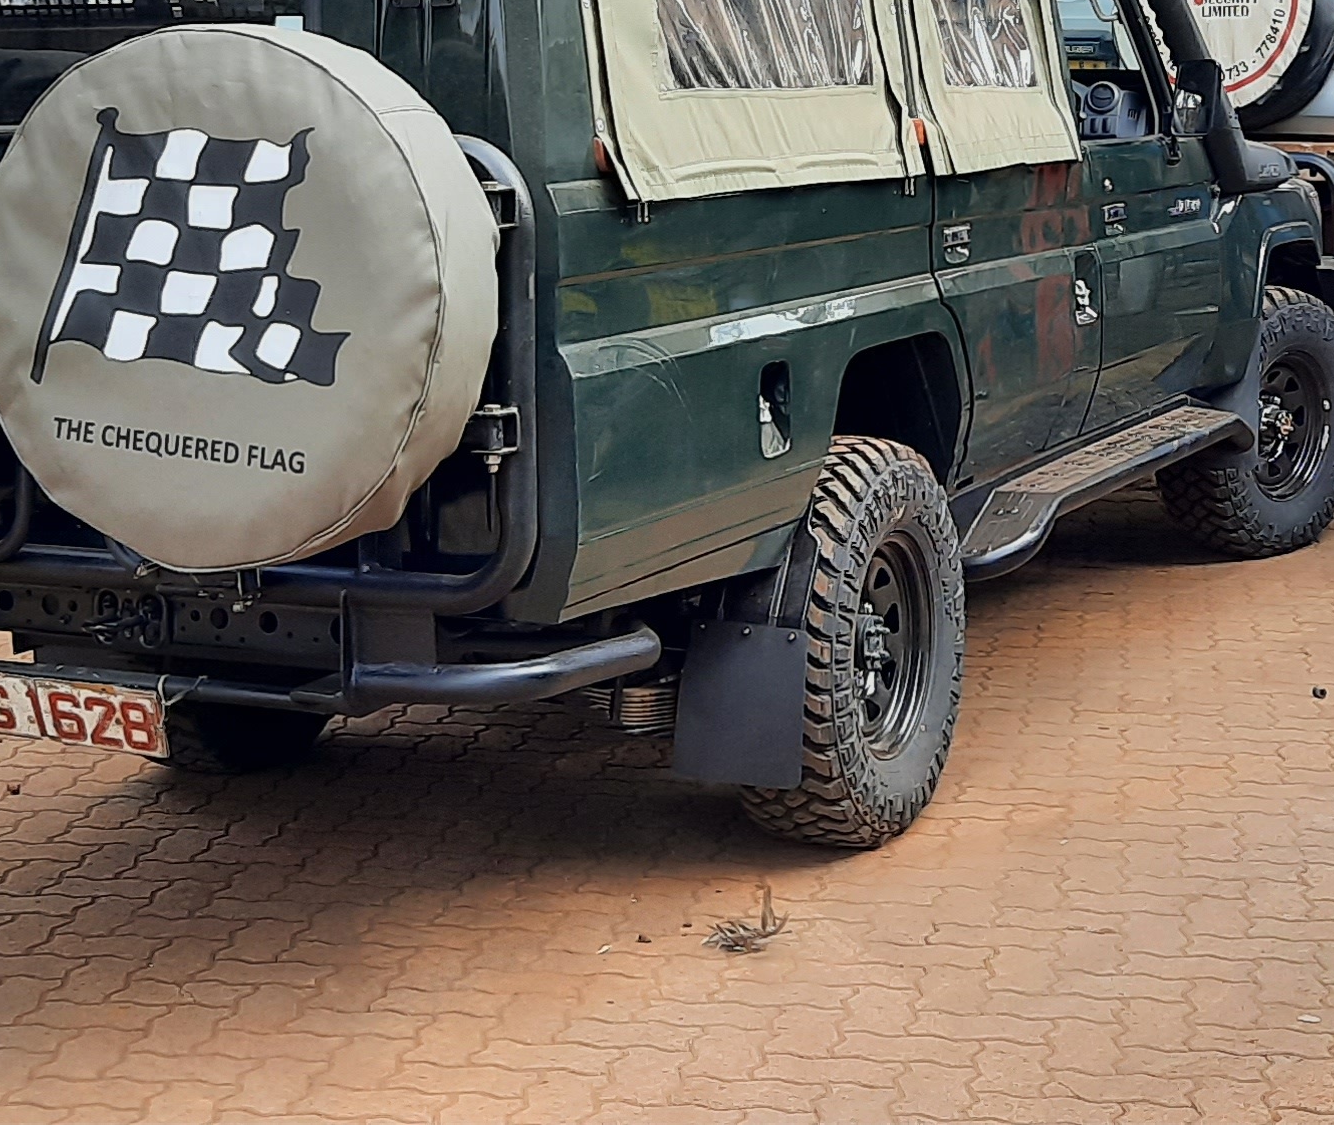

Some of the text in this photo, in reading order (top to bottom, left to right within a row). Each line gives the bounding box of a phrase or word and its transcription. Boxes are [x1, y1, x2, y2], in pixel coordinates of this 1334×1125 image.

[1201, 4, 1250, 17] LIMITED
[1255, 8, 1286, 59] 778410
[54, 416, 306, 475] THE CHEQUERED FLAG
[25, 686, 159, 752] 1628
